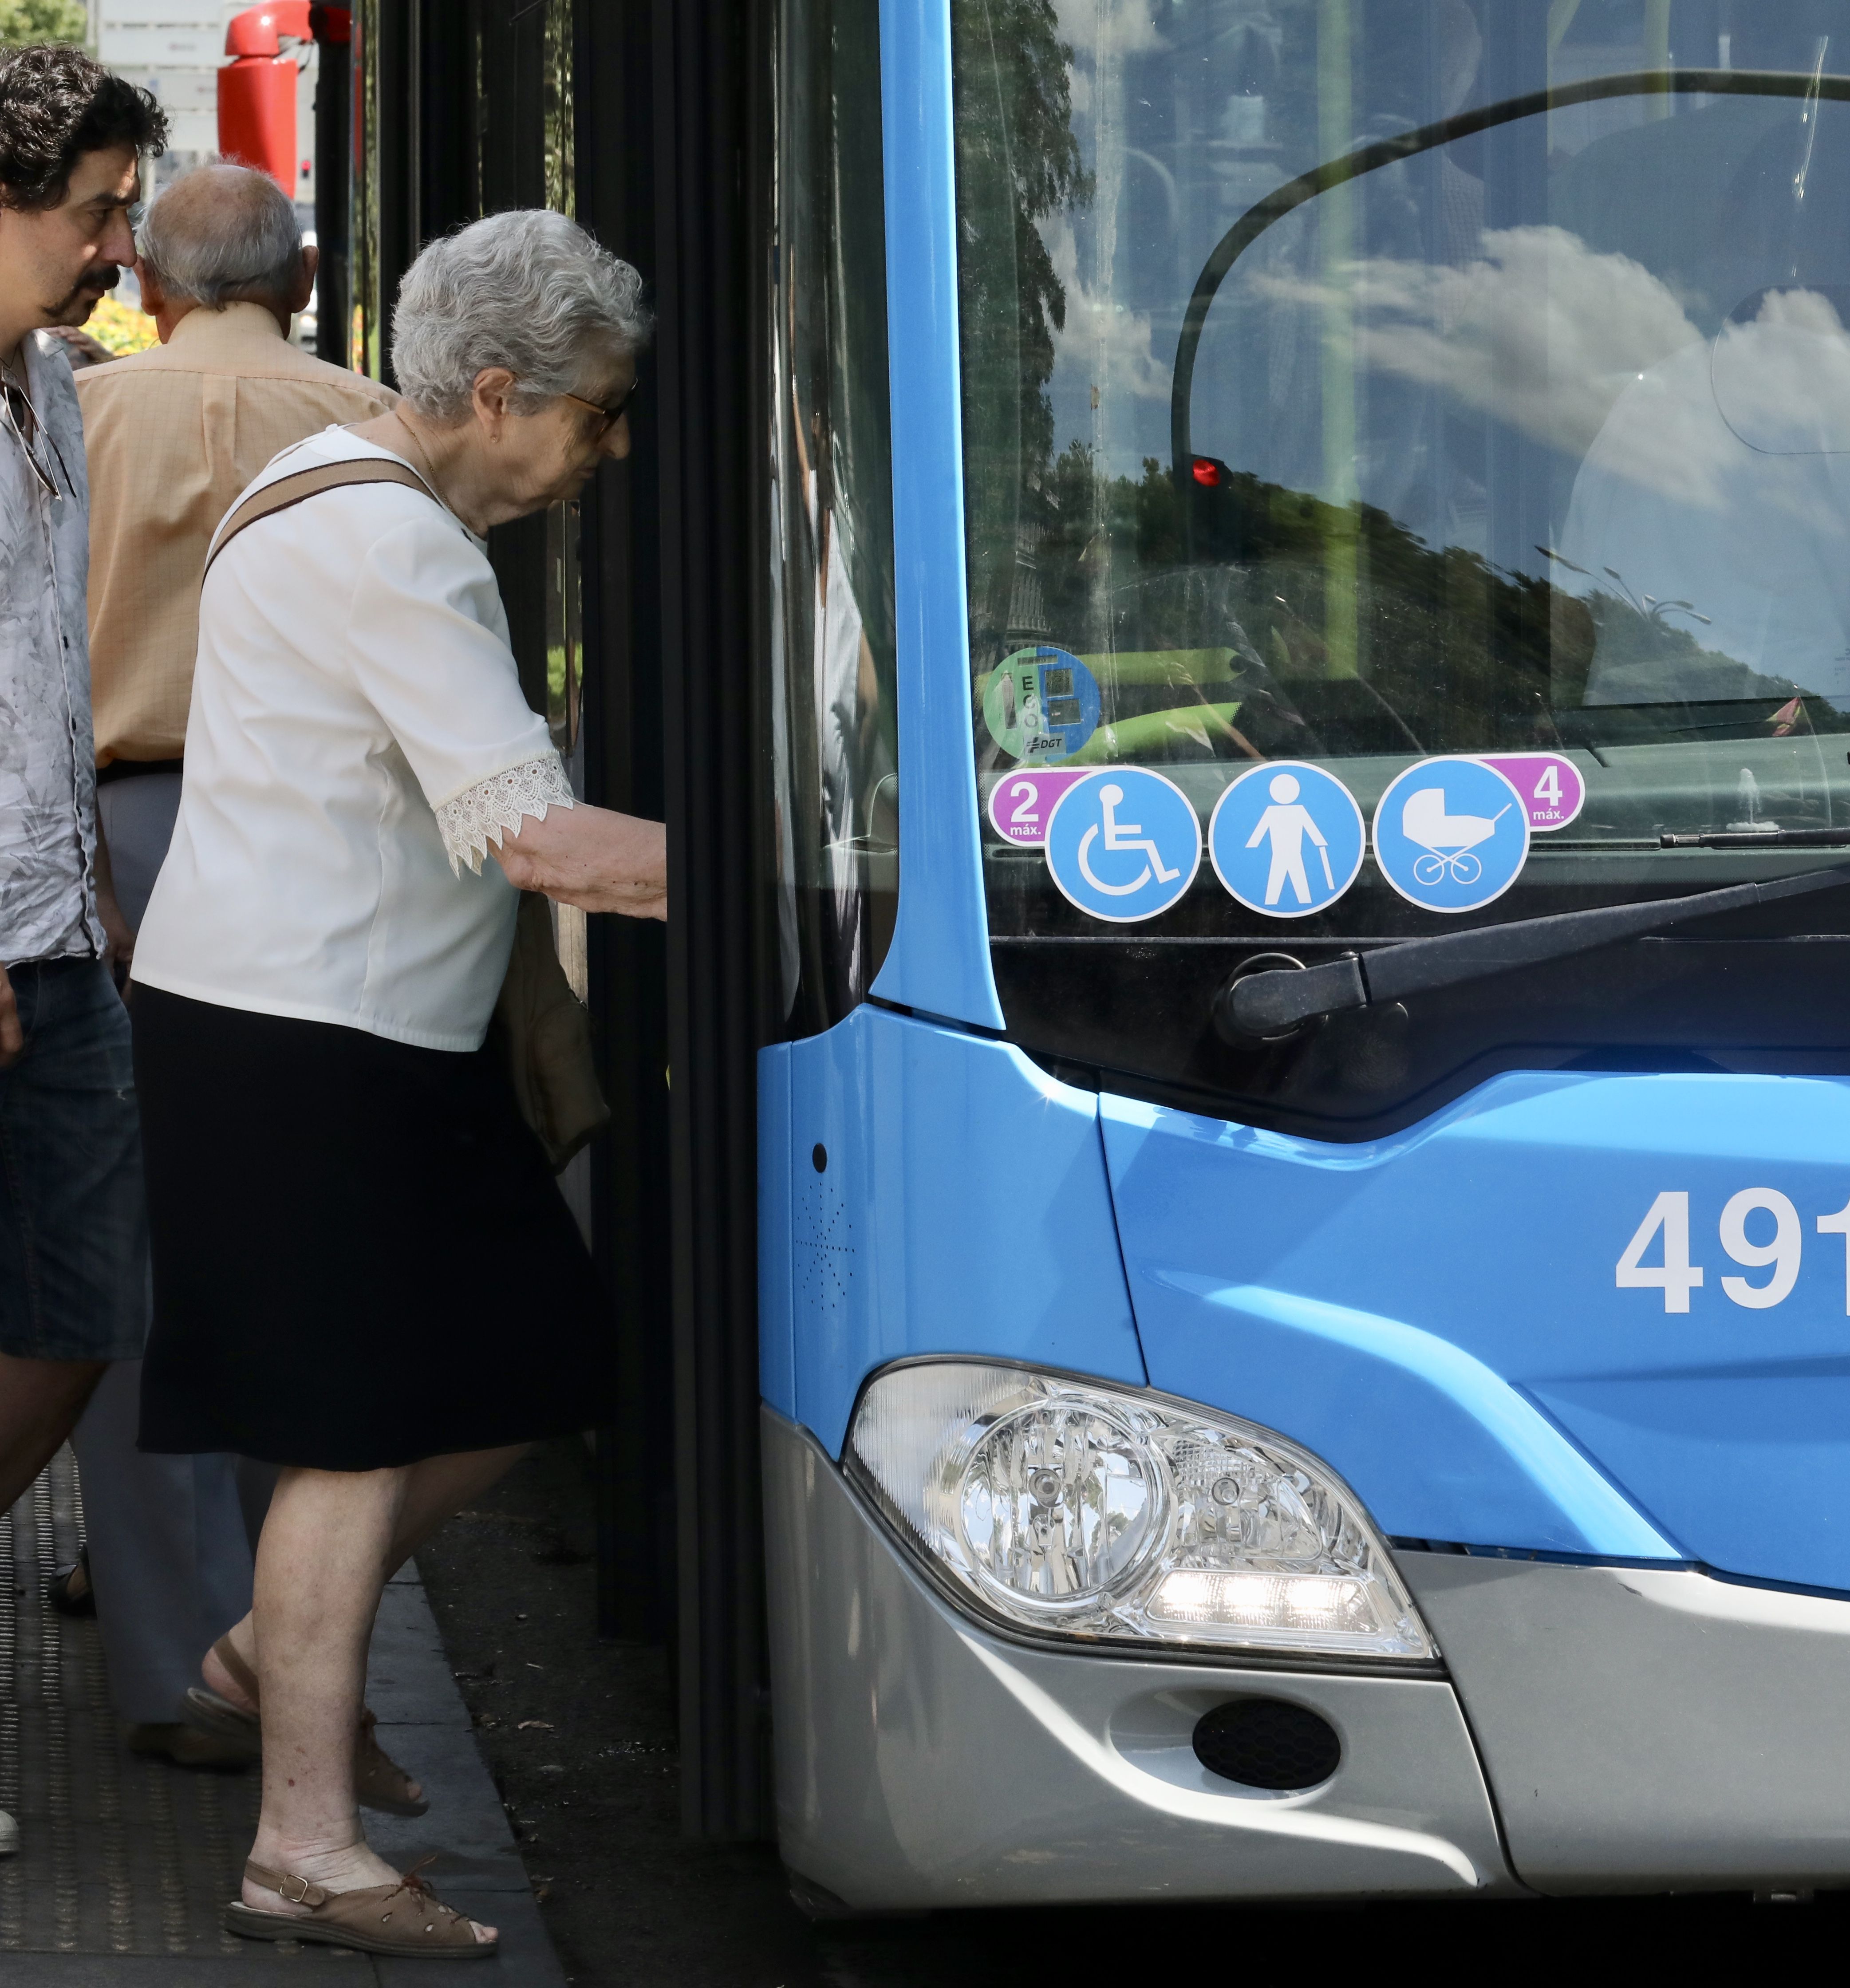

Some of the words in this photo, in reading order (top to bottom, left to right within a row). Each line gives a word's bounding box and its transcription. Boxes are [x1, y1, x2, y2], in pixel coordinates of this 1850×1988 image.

[1022, 676, 1038, 728] ECO
[1041, 738, 1062, 748] DGT
[1534, 765, 1563, 806] 4
[1010, 781, 1039, 822] 2
[1533, 808, 1564, 820] máx.
[1010, 823, 1041, 836] máx.
